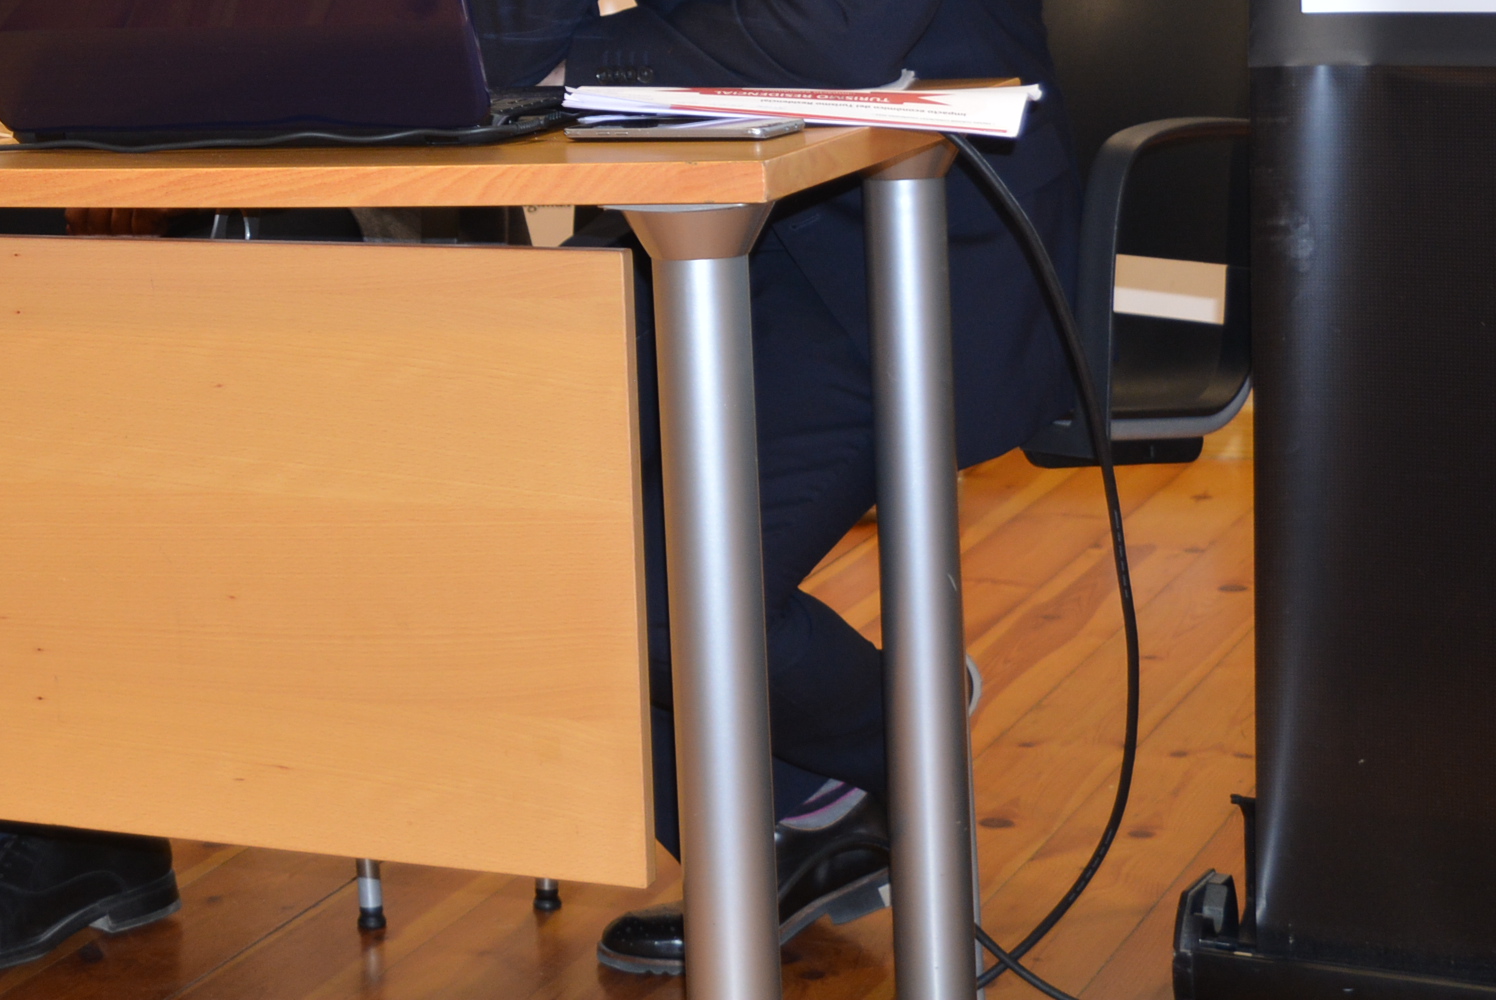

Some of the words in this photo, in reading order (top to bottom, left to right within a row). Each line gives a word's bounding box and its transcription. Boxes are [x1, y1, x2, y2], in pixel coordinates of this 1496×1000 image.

[714, 90, 812, 100] RESIDENCIAL
[817, 94, 890, 103] TURISMO
[761, 98, 814, 106] Residencial
[928, 109, 967, 117] Impacto
